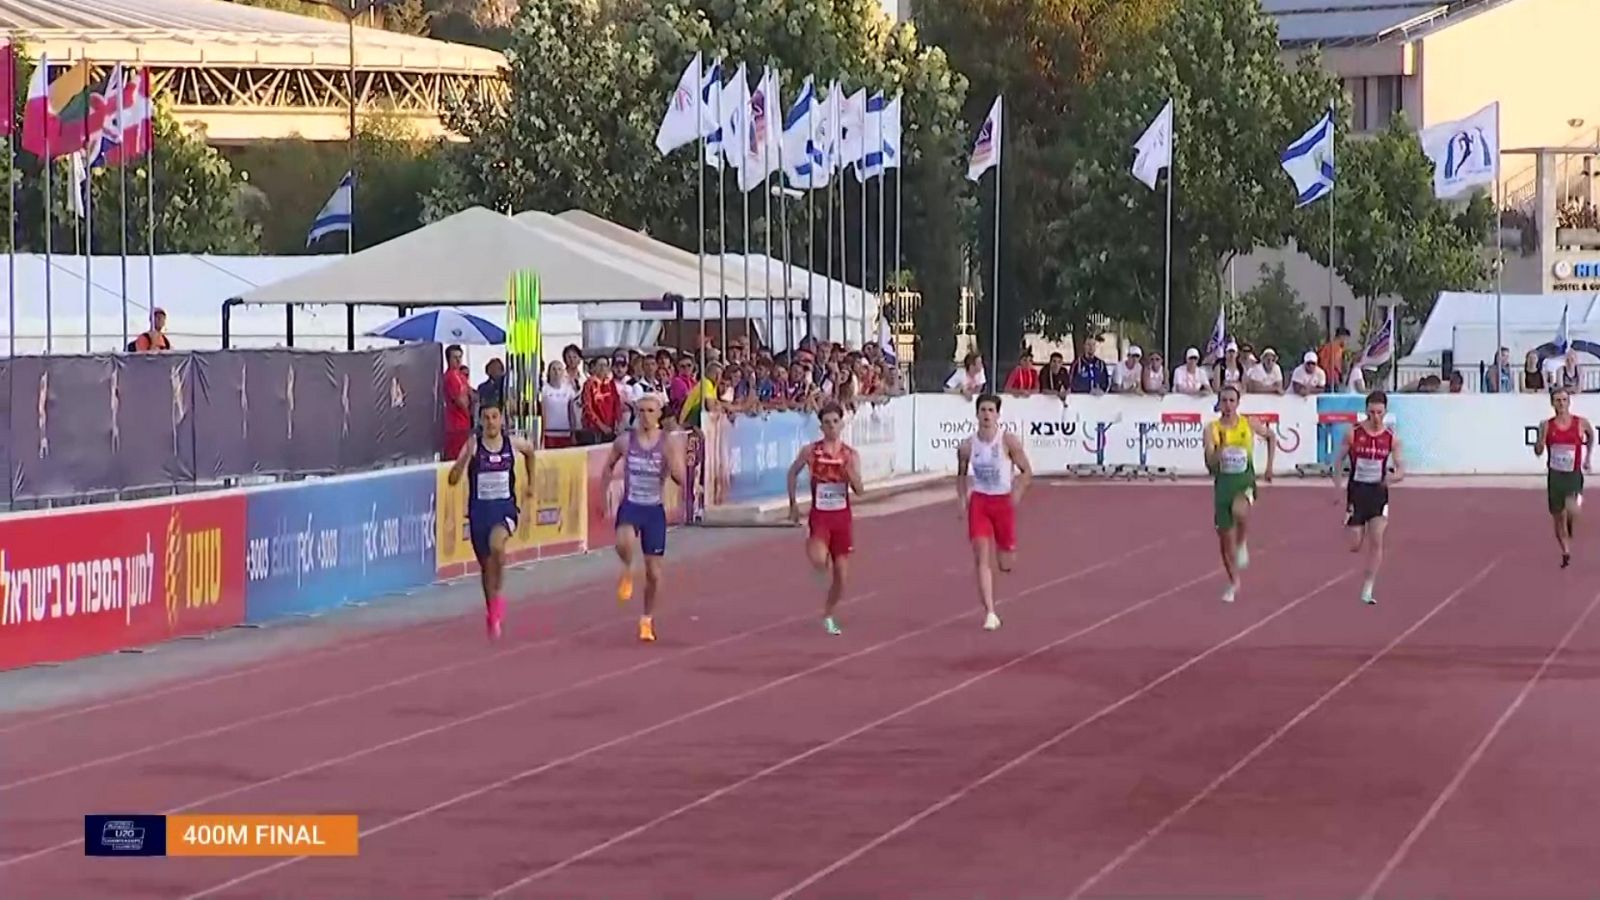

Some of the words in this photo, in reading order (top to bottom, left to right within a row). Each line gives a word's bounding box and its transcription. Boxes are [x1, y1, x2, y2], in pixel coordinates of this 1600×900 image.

[1552, 283, 1580, 291] HOSTEL
[1031, 421, 1077, 436] שיבא
[0, 549, 62, 626] בישראל
[66, 557, 123, 616] הספורט
[126, 532, 154, 626] למען
[186, 527, 222, 609] טוטו
